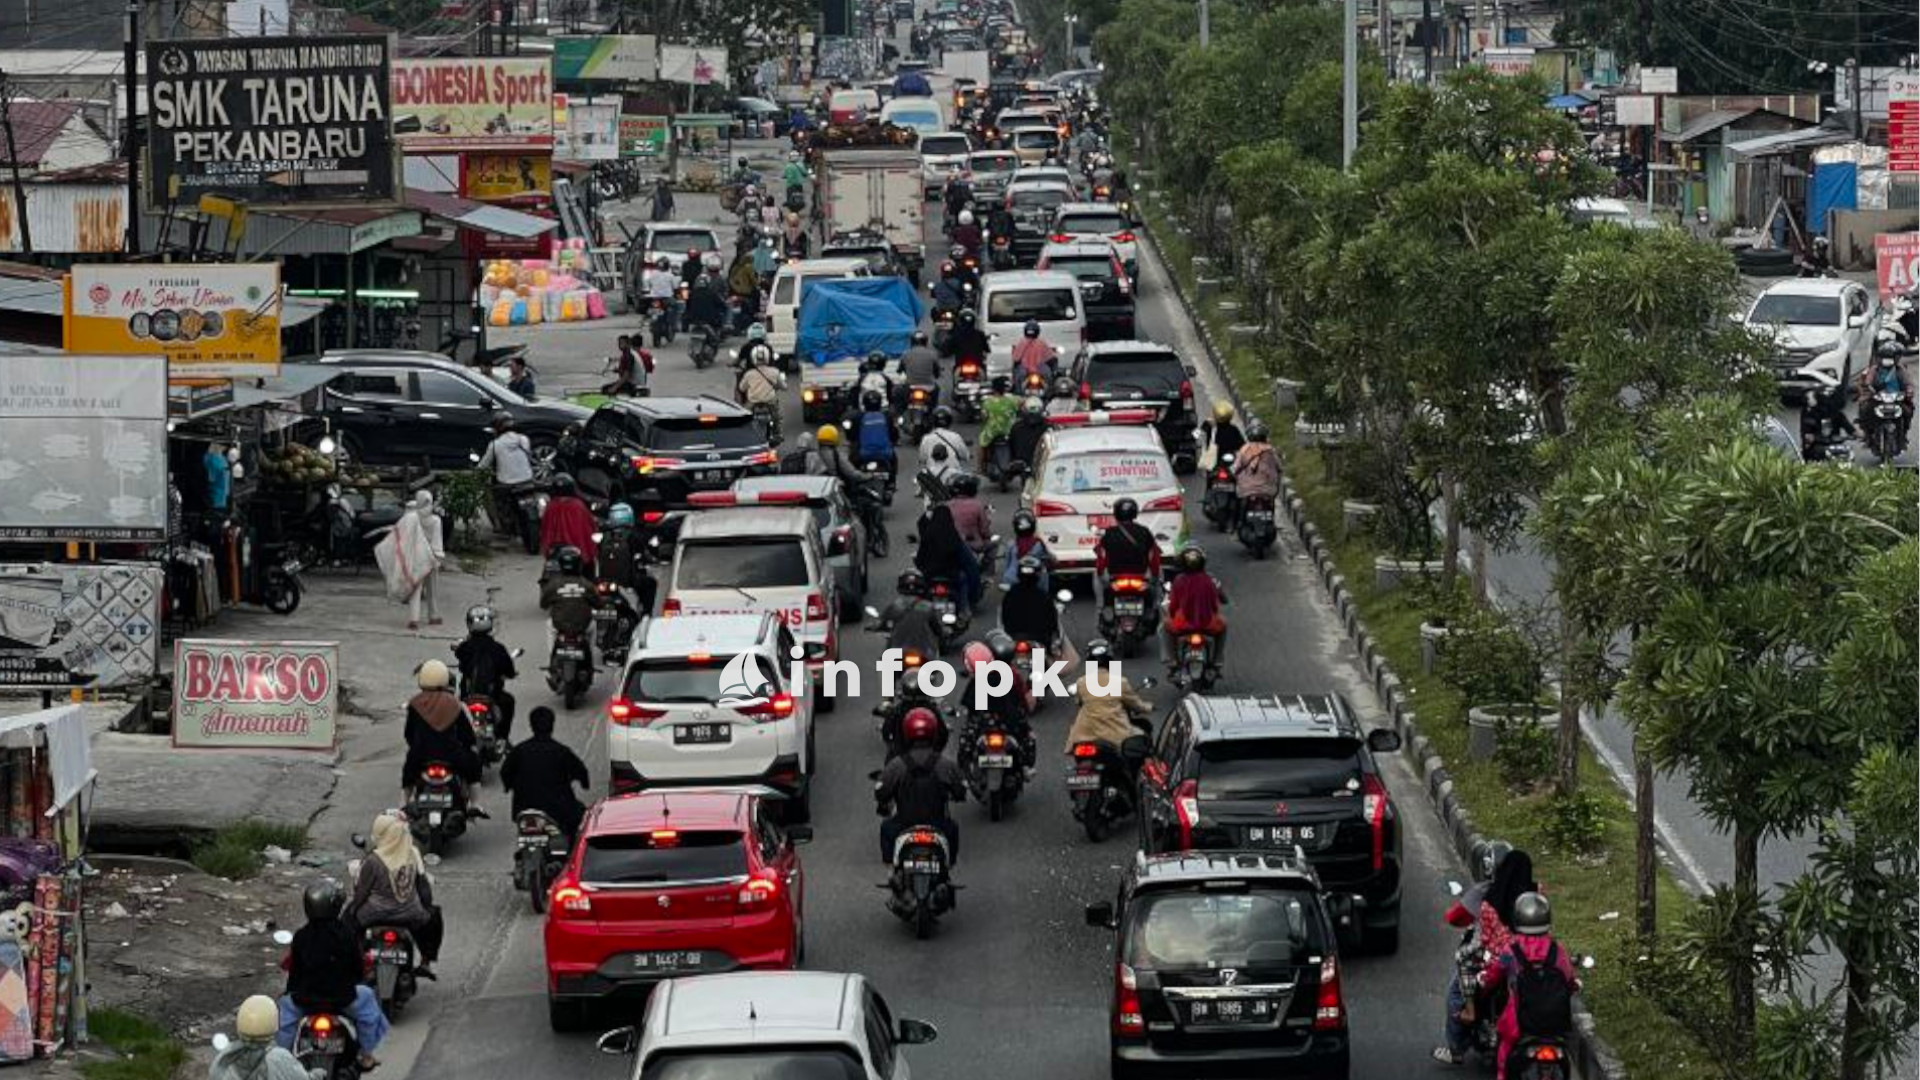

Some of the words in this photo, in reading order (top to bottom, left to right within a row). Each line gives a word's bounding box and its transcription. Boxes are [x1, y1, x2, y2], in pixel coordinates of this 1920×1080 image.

[194, 50, 247, 72] YAYASAN
[250, 48, 297, 70] TARUNA
[299, 46, 352, 69] MANDIRI
[353, 44, 384, 67] RIAU
[153, 78, 231, 128] SMK
[242, 74, 384, 126] TARUNA
[392, 65, 489, 105] DONESIA
[493, 64, 547, 113] Sport
[173, 127, 367, 162] PEKANBARU
[1100, 466, 1159, 477] STUNTING
[184, 651, 330, 704] BAKSO
